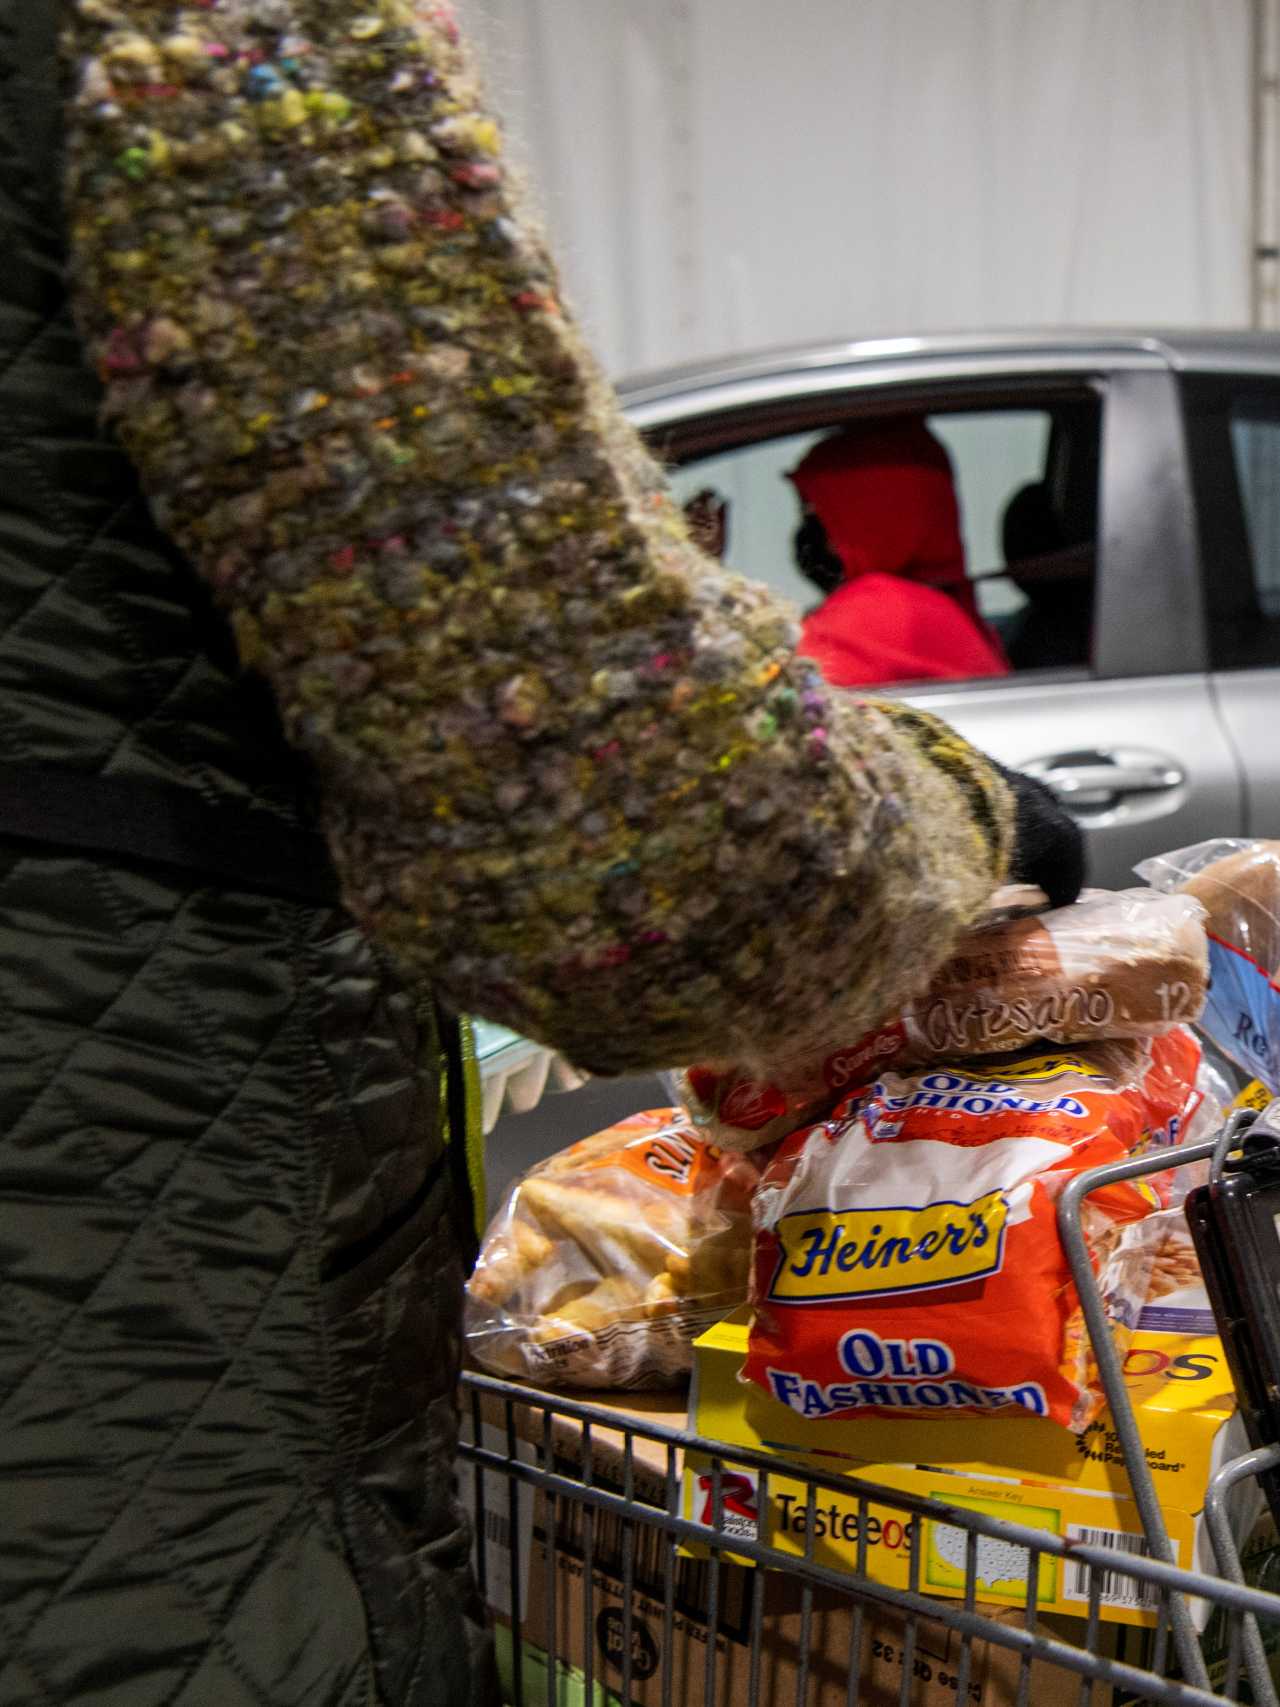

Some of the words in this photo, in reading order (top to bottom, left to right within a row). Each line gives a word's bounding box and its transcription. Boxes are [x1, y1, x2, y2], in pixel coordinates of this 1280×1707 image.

[1153, 979, 1192, 1022] 12
[919, 1074, 1016, 1094] OLD
[790, 1212, 989, 1277] Heiner's
[841, 1331, 951, 1378] OLD
[767, 1369, 1048, 1416] FASHIONED
